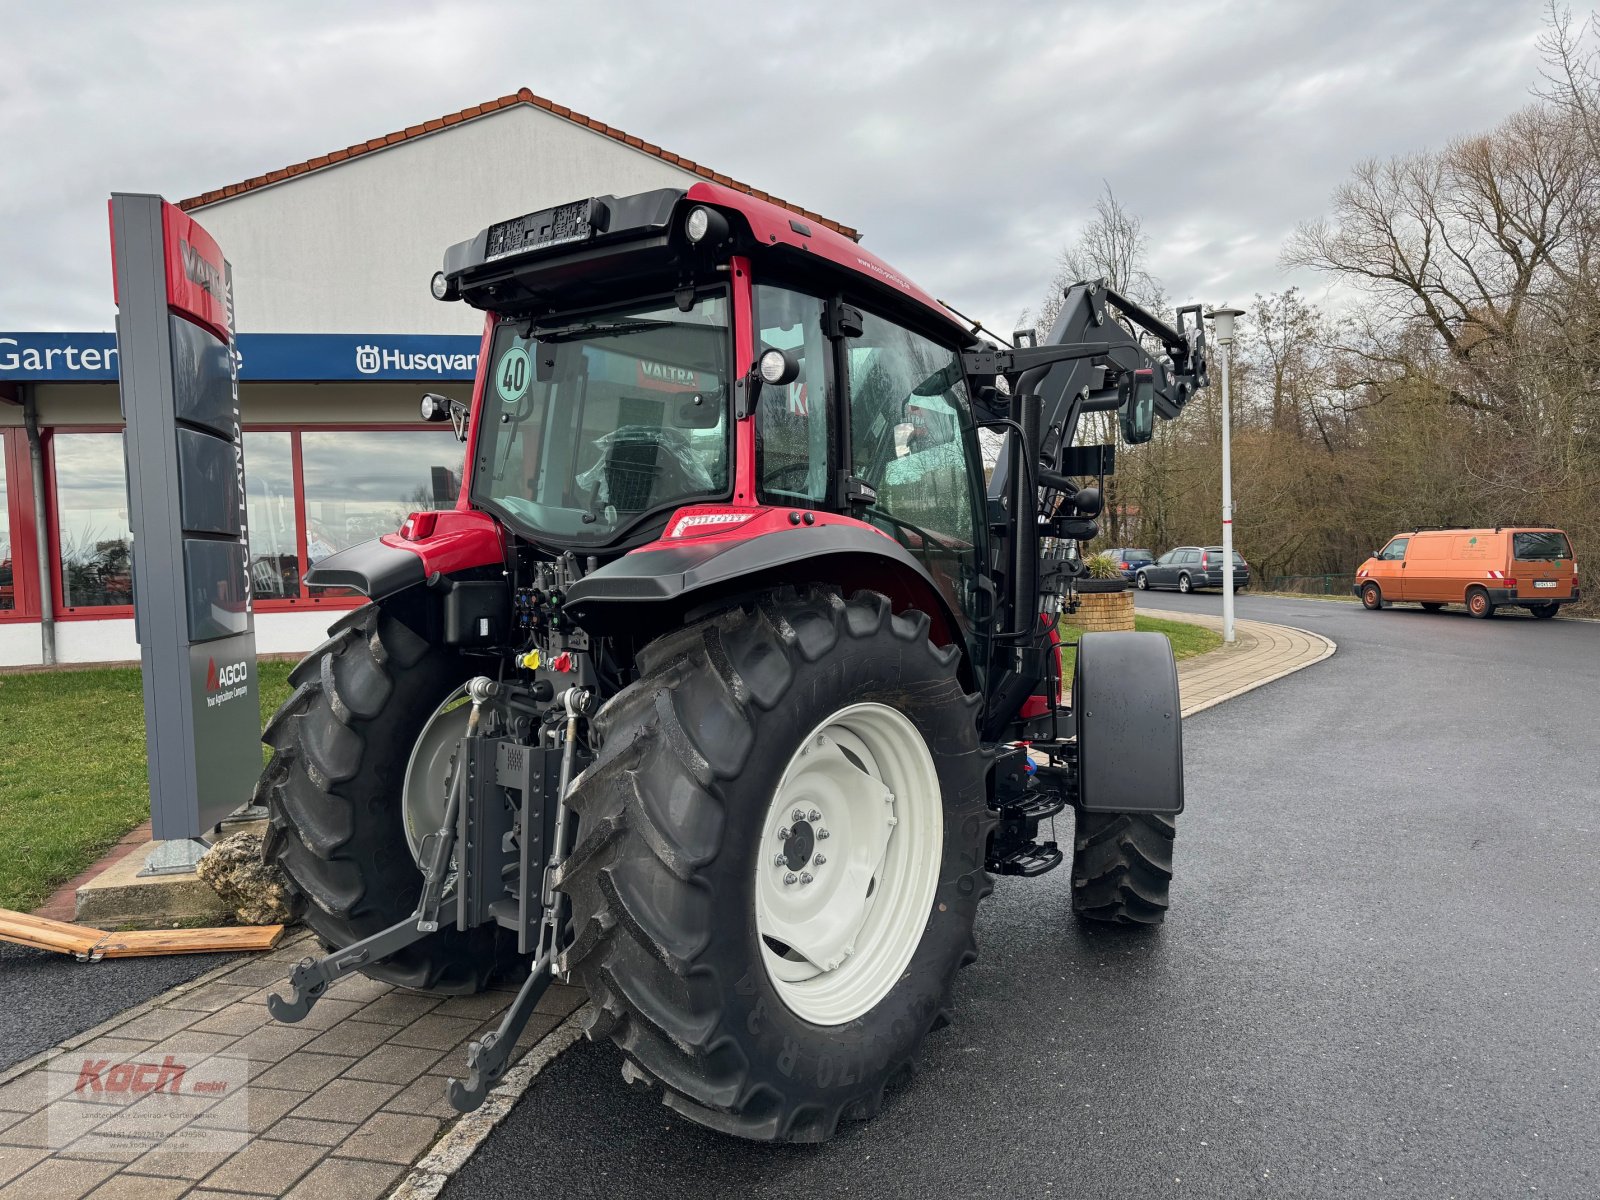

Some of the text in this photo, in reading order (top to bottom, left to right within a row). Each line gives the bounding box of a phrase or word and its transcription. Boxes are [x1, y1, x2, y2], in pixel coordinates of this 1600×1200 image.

[382, 349, 480, 374] Husqvar
[503, 357, 525, 391] 40
[641, 360, 694, 381] VALTRA
[219, 661, 247, 688] AGCO
